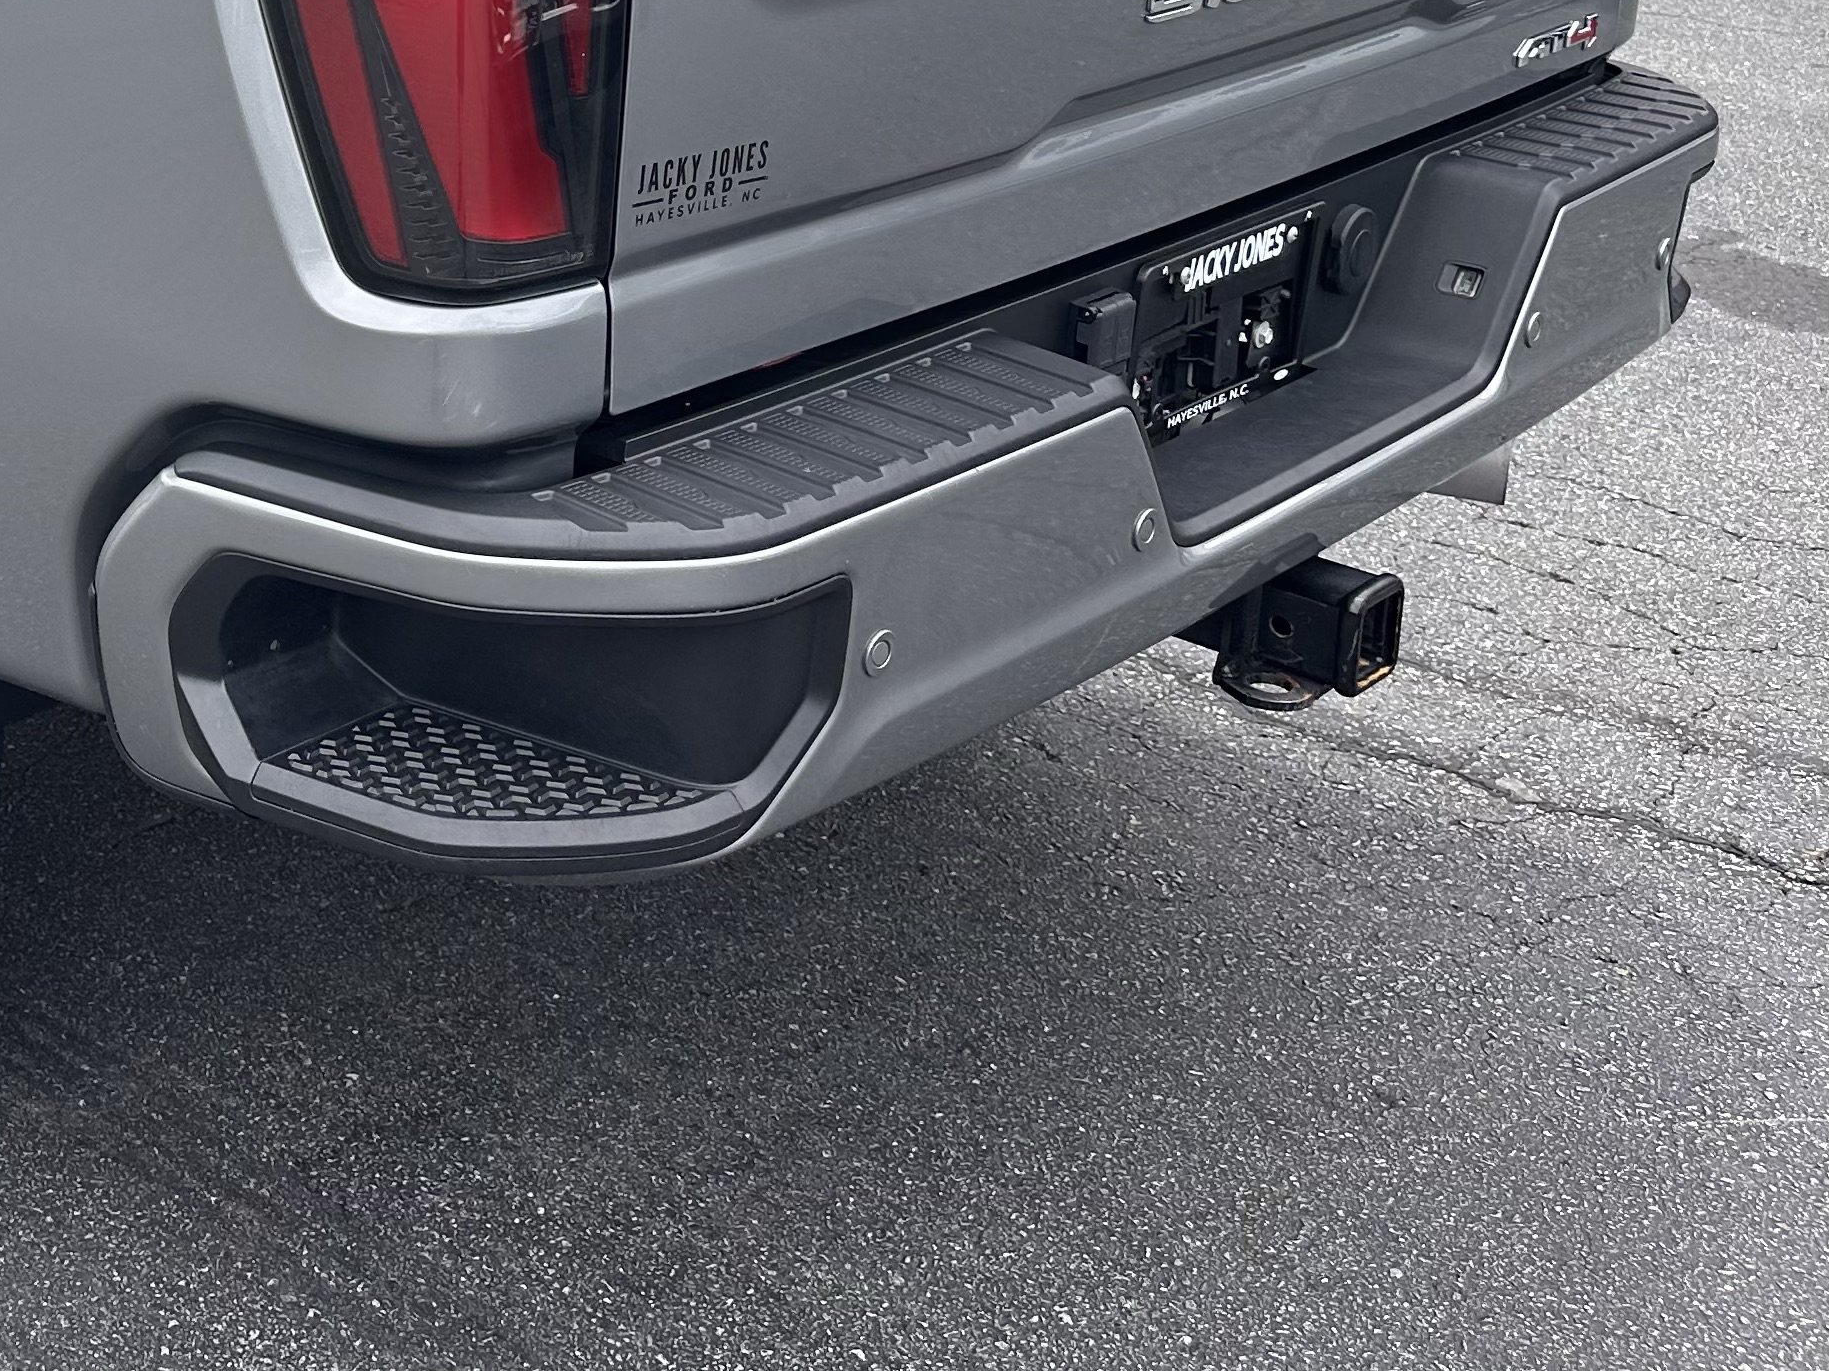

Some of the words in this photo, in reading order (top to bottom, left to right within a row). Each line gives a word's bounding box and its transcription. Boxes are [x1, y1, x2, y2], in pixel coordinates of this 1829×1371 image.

[1512, 13, 1599, 68] AT4
[637, 153, 702, 195] JACKY
[708, 140, 769, 180] JONES
[668, 177, 733, 205] FORD
[741, 188, 761, 202] NC
[1184, 241, 1237, 292] JACKY
[1233, 223, 1286, 273] JONES
